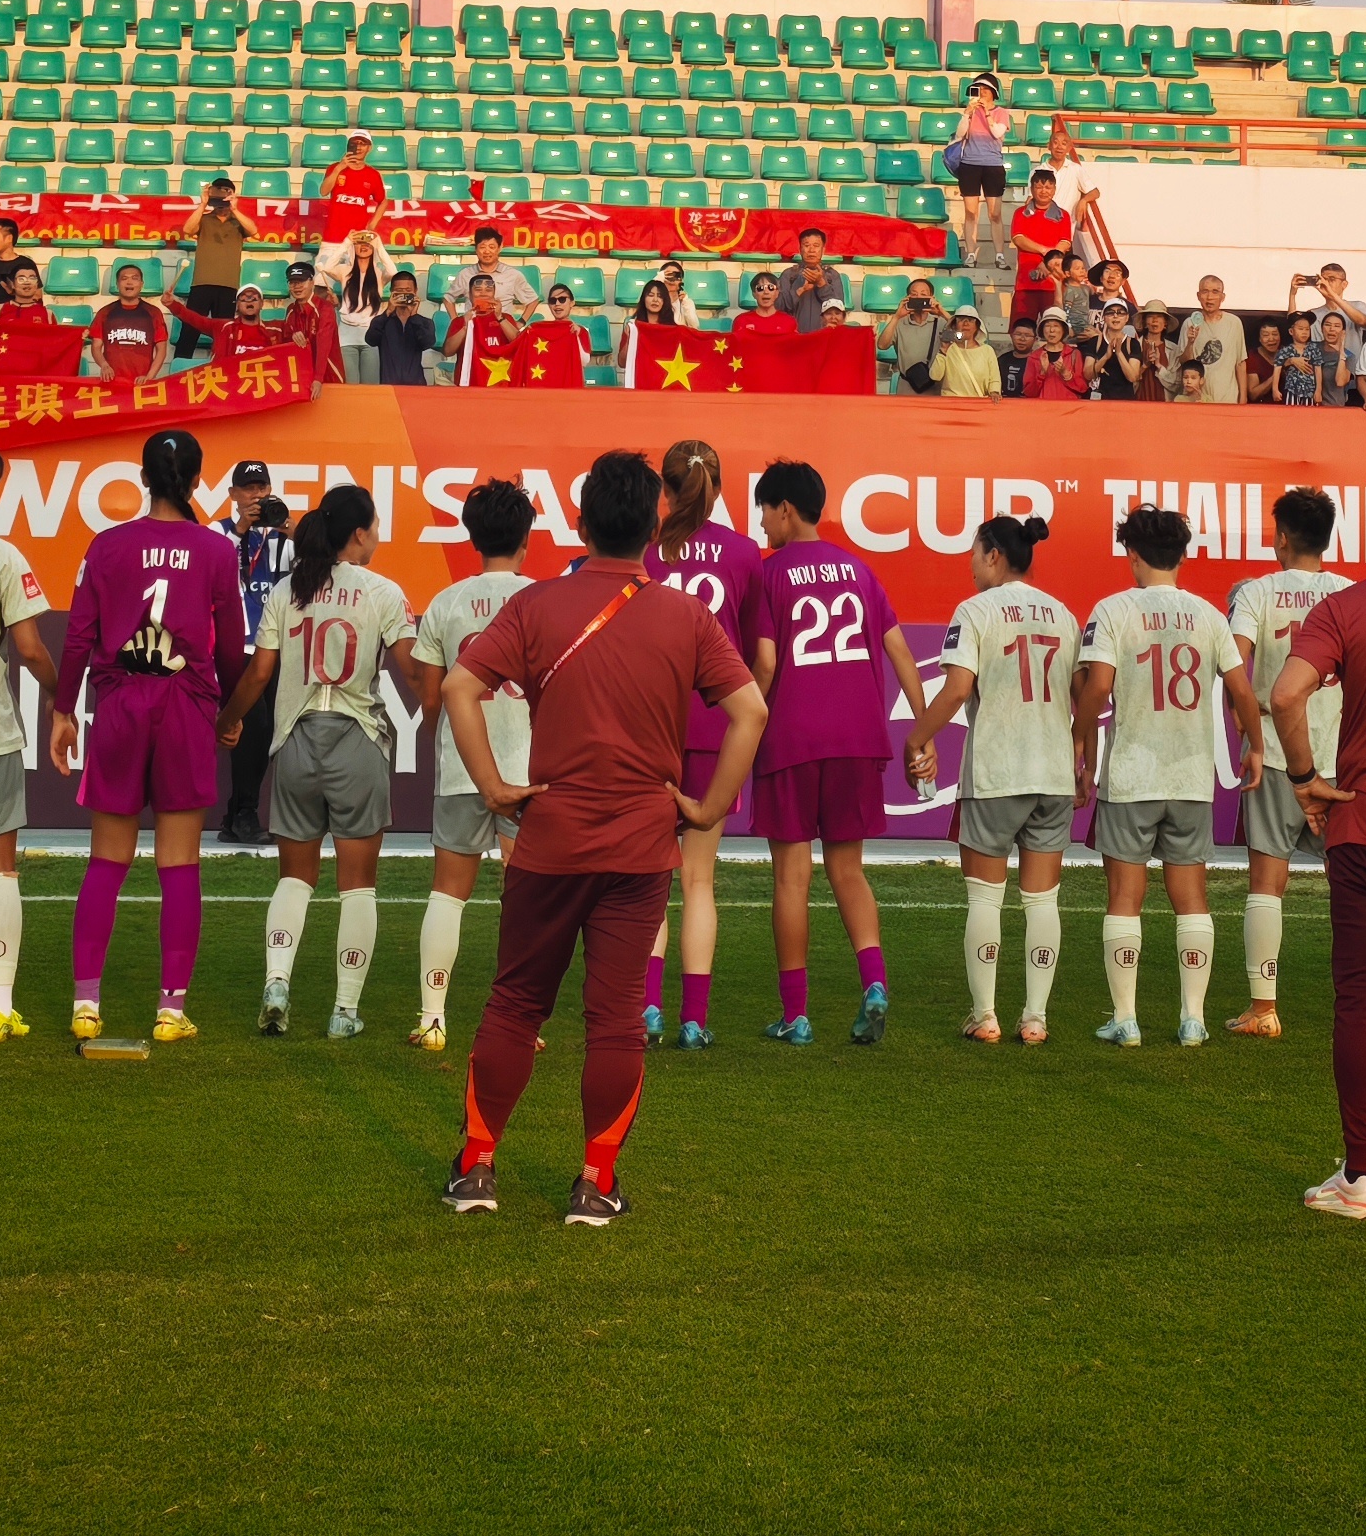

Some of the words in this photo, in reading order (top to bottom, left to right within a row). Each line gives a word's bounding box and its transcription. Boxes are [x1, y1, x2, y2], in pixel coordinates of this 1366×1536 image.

[17, 223, 119, 241] ootball
[840, 474, 1054, 555] CUP
[142, 548, 166, 569] LIU
[169, 548, 190, 570] CH
[787, 565, 817, 586] HOU
[819, 563, 839, 583] SH
[142, 578, 169, 634] 1
[352, 588, 363, 607] F
[471, 597, 491, 618] YU
[1274, 590, 1316, 609] ZENG
[1001, 605, 1025, 623] XIE
[1027, 604, 1040, 621] Z
[1142, 612, 1167, 632] WU
[1184, 612, 1195, 632] X
[791, 591, 871, 667] 22
[289, 616, 358, 686] 10
[1003, 633, 1061, 703] 17
[1136, 642, 1202, 712] 18
